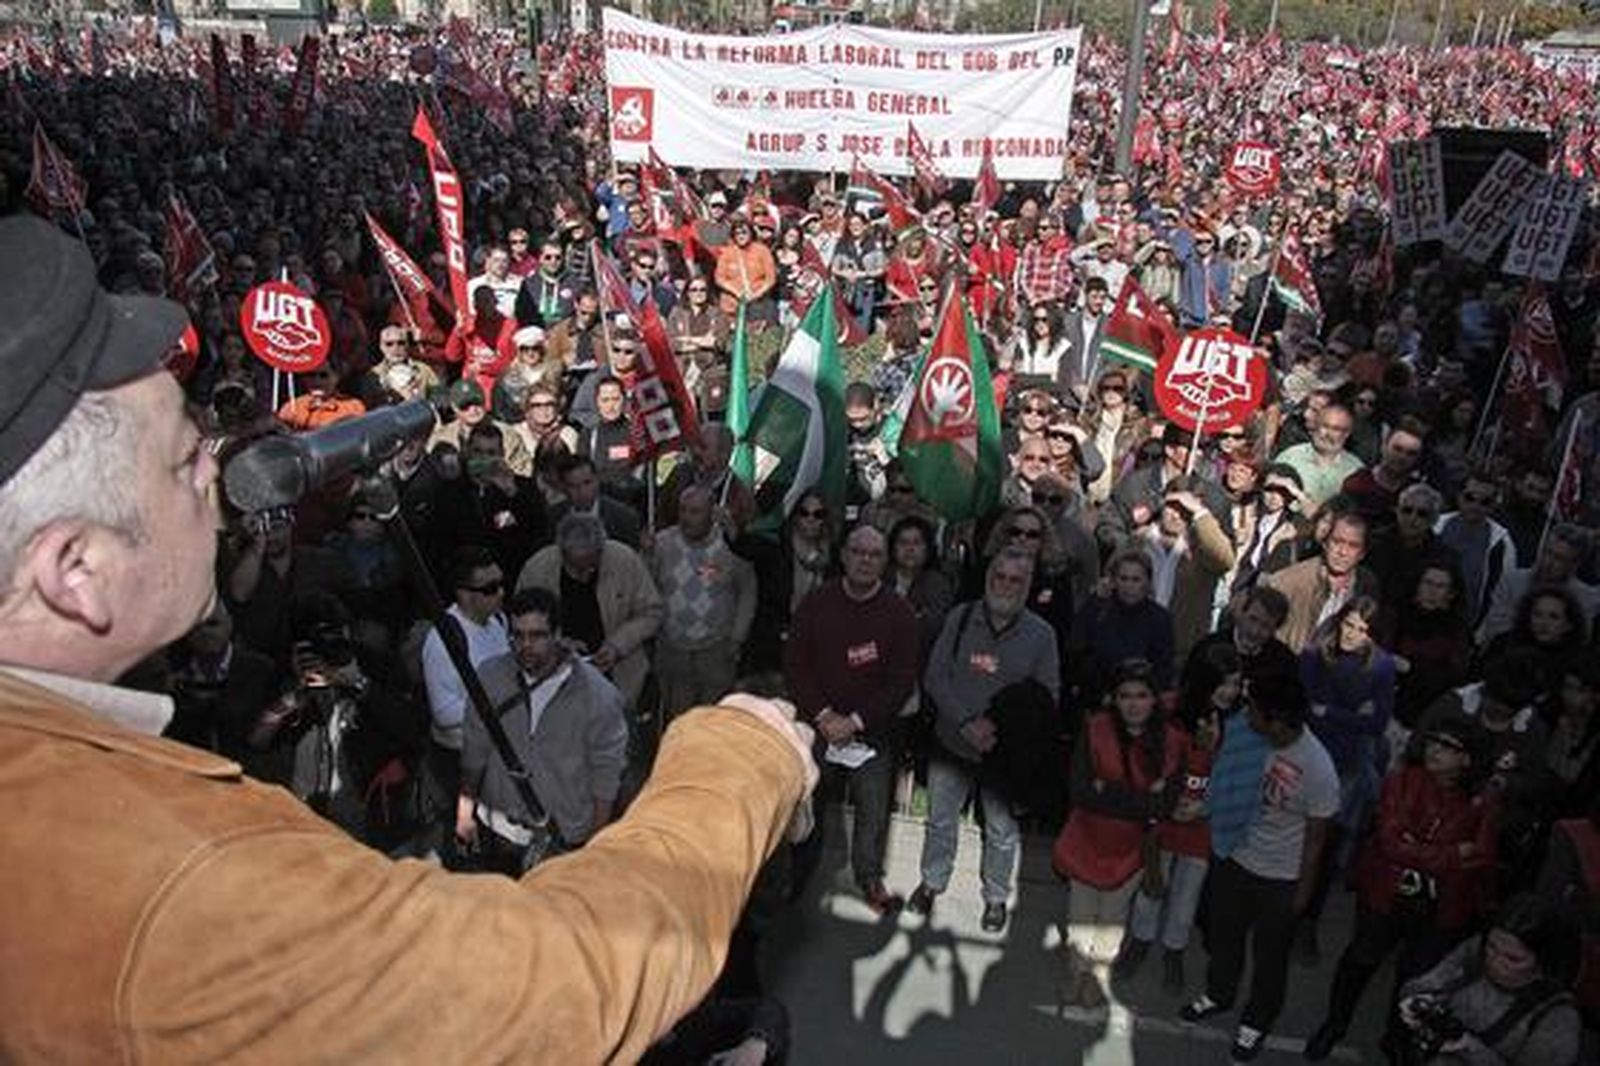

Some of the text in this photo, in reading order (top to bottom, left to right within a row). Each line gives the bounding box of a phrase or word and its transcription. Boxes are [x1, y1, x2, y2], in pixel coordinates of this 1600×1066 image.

[607, 29, 1075, 72] CONTRA LA REFORMA LABORAL DEL GOB DEL PP
[785, 88, 855, 110] HUELGA
[867, 91, 952, 115] GENERAL
[746, 132, 805, 153] AGRUP
[817, 134, 828, 153] S
[839, 134, 883, 156] JOSE
[928, 141, 951, 159] LA
[963, 139, 1066, 158] RICONADA
[1233, 146, 1272, 170] UGT
[1391, 142, 1434, 167] UT
[1526, 201, 1577, 229] UGT
[1518, 227, 1567, 255] UGT
[254, 288, 314, 330] UGT
[1173, 335, 1253, 383] UGT
